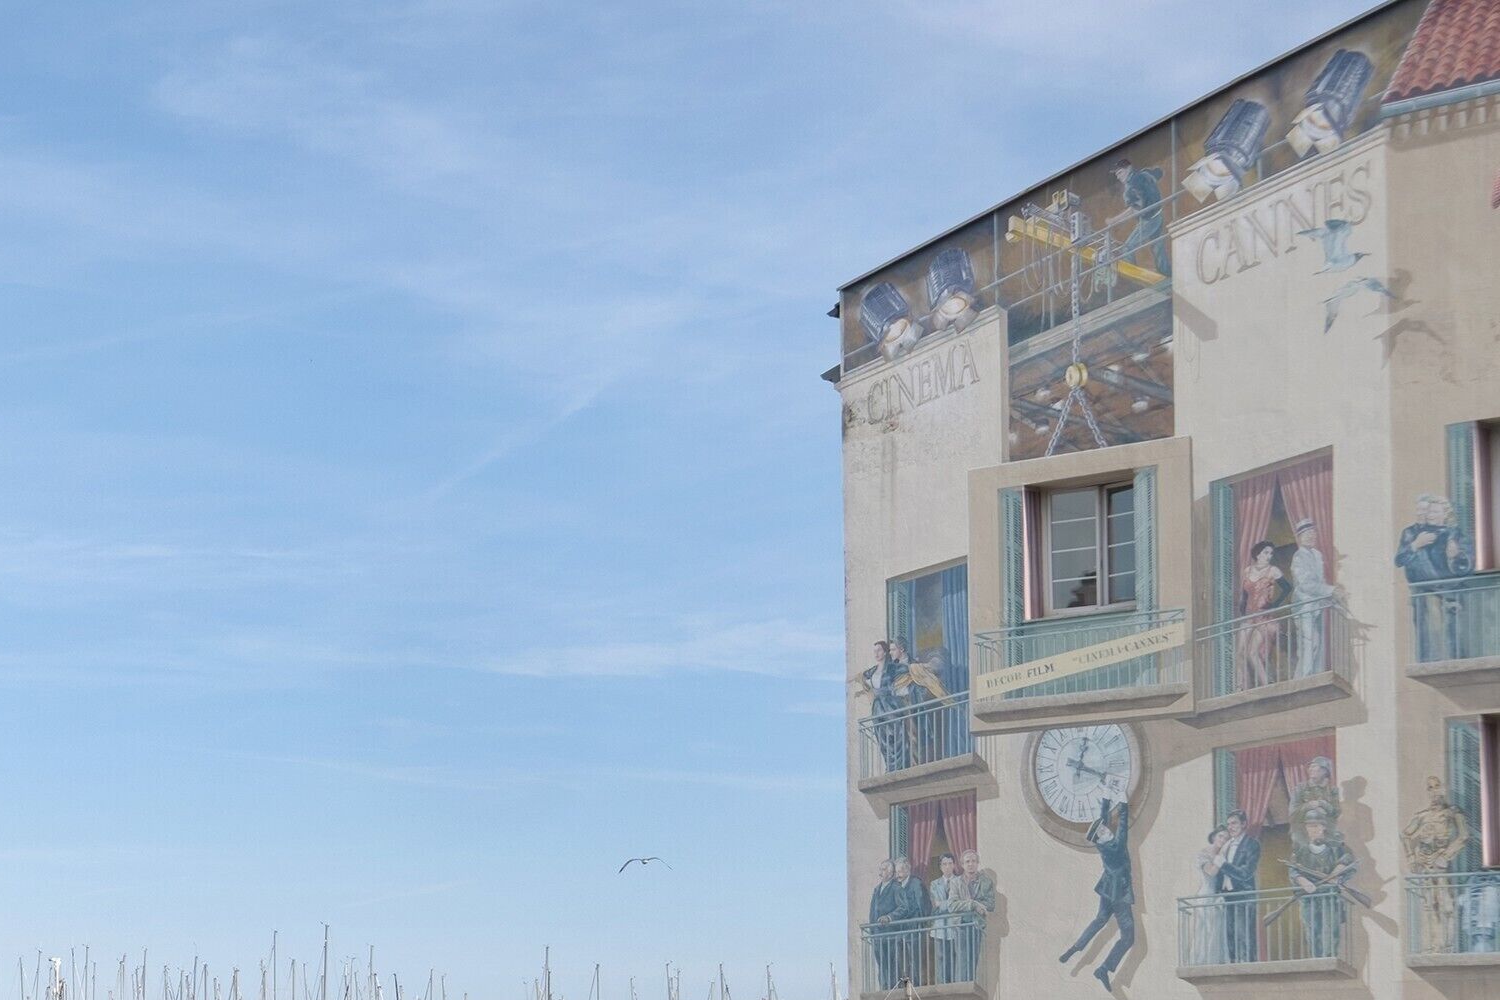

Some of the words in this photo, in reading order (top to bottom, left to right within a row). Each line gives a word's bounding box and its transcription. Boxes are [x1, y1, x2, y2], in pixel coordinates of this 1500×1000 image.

[1196, 158, 1372, 285] CANNES
[867, 339, 980, 425] CINEMA
[1027, 664, 1055, 679] FILM
